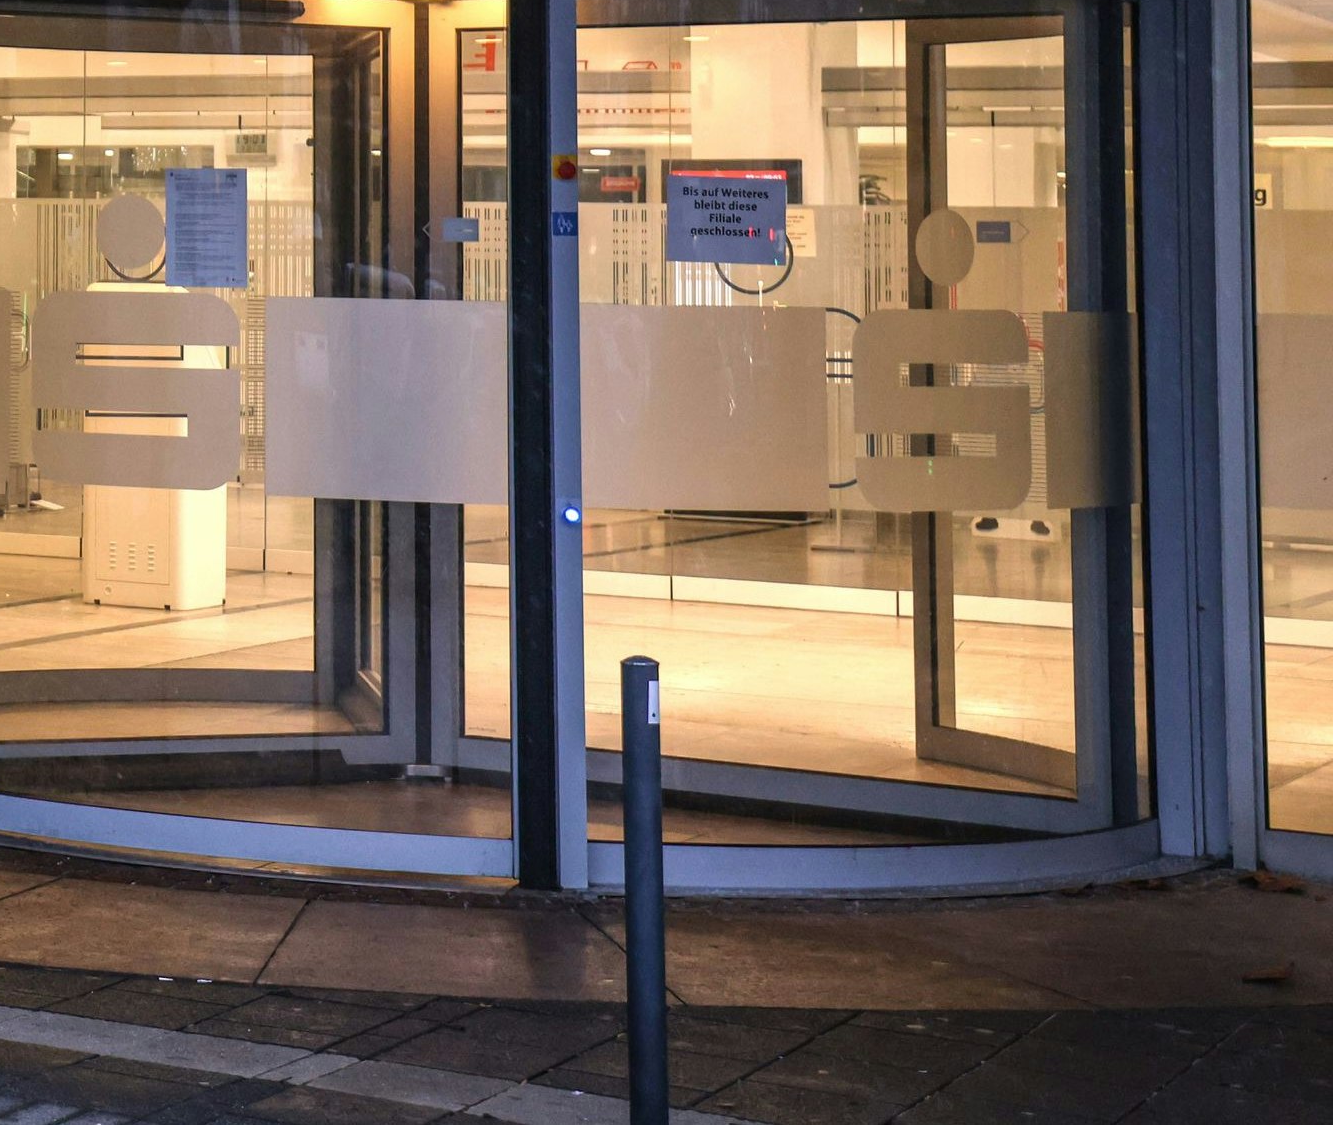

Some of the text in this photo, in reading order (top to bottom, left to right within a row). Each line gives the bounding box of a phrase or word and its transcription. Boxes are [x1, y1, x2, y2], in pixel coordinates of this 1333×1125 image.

[683, 186, 769, 199] Bis auf Weiteres
[694, 199, 757, 212] bleibt diese
[709, 213, 742, 224] Filiale
[690, 226, 761, 239] geschlossen!
